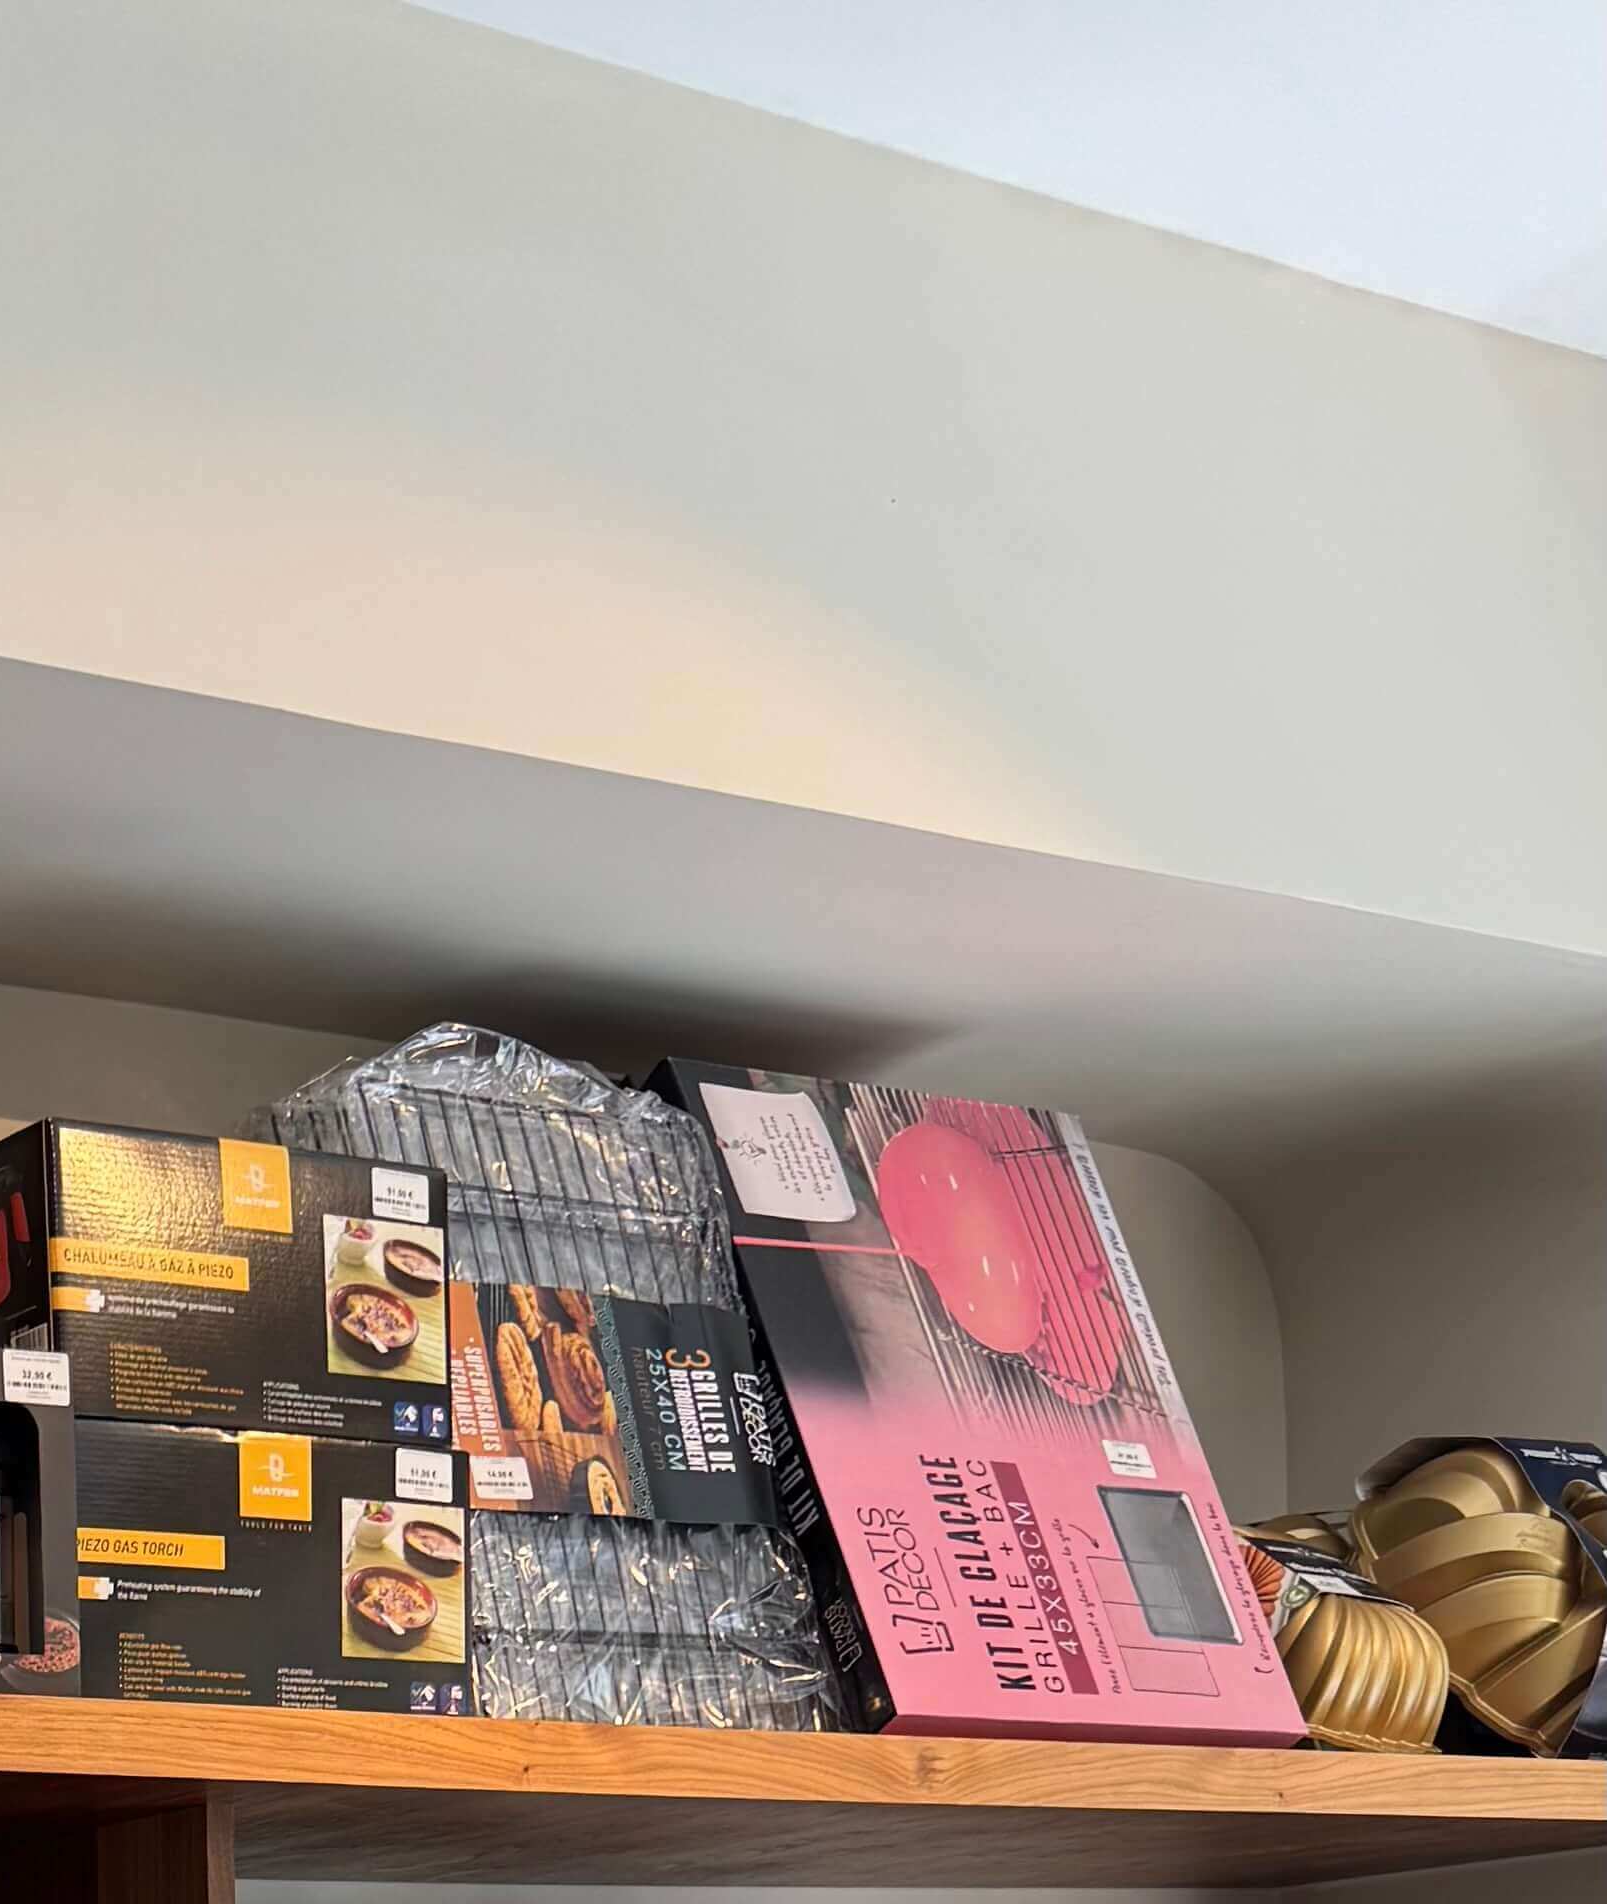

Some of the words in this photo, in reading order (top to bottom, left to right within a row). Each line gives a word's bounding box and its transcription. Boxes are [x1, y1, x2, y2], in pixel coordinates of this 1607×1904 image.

[64, 1248, 145, 1271] CHALUMEAU
[198, 1263, 234, 1280] PIEZO
[464, 1344, 502, 1452] SUPERPOSABLES
[666, 1348, 711, 1369] 3
[645, 1348, 675, 1425] 25X40
[664, 1434, 685, 1471] CM
[669, 1369, 708, 1473] REFROIDISSEMENT
[693, 1369, 728, 1444] GRILLES
[709, 1451, 737, 1473] DE
[966, 1459, 1005, 1523] BAC
[77, 1538, 109, 1552] IEZO
[113, 1540, 138, 1554] GAS
[143, 1541, 184, 1557] TORCH
[856, 1507, 908, 1608] PATIS
[888, 1507, 940, 1612] DECOR
[919, 1454, 997, 1582] GLAÇAGE
[969, 1595, 1007, 1630] DE
[1007, 1501, 1080, 1657] 45X33CM
[986, 1641, 1037, 1692] KIT
[1005, 1573, 1065, 1694] GRILLE
